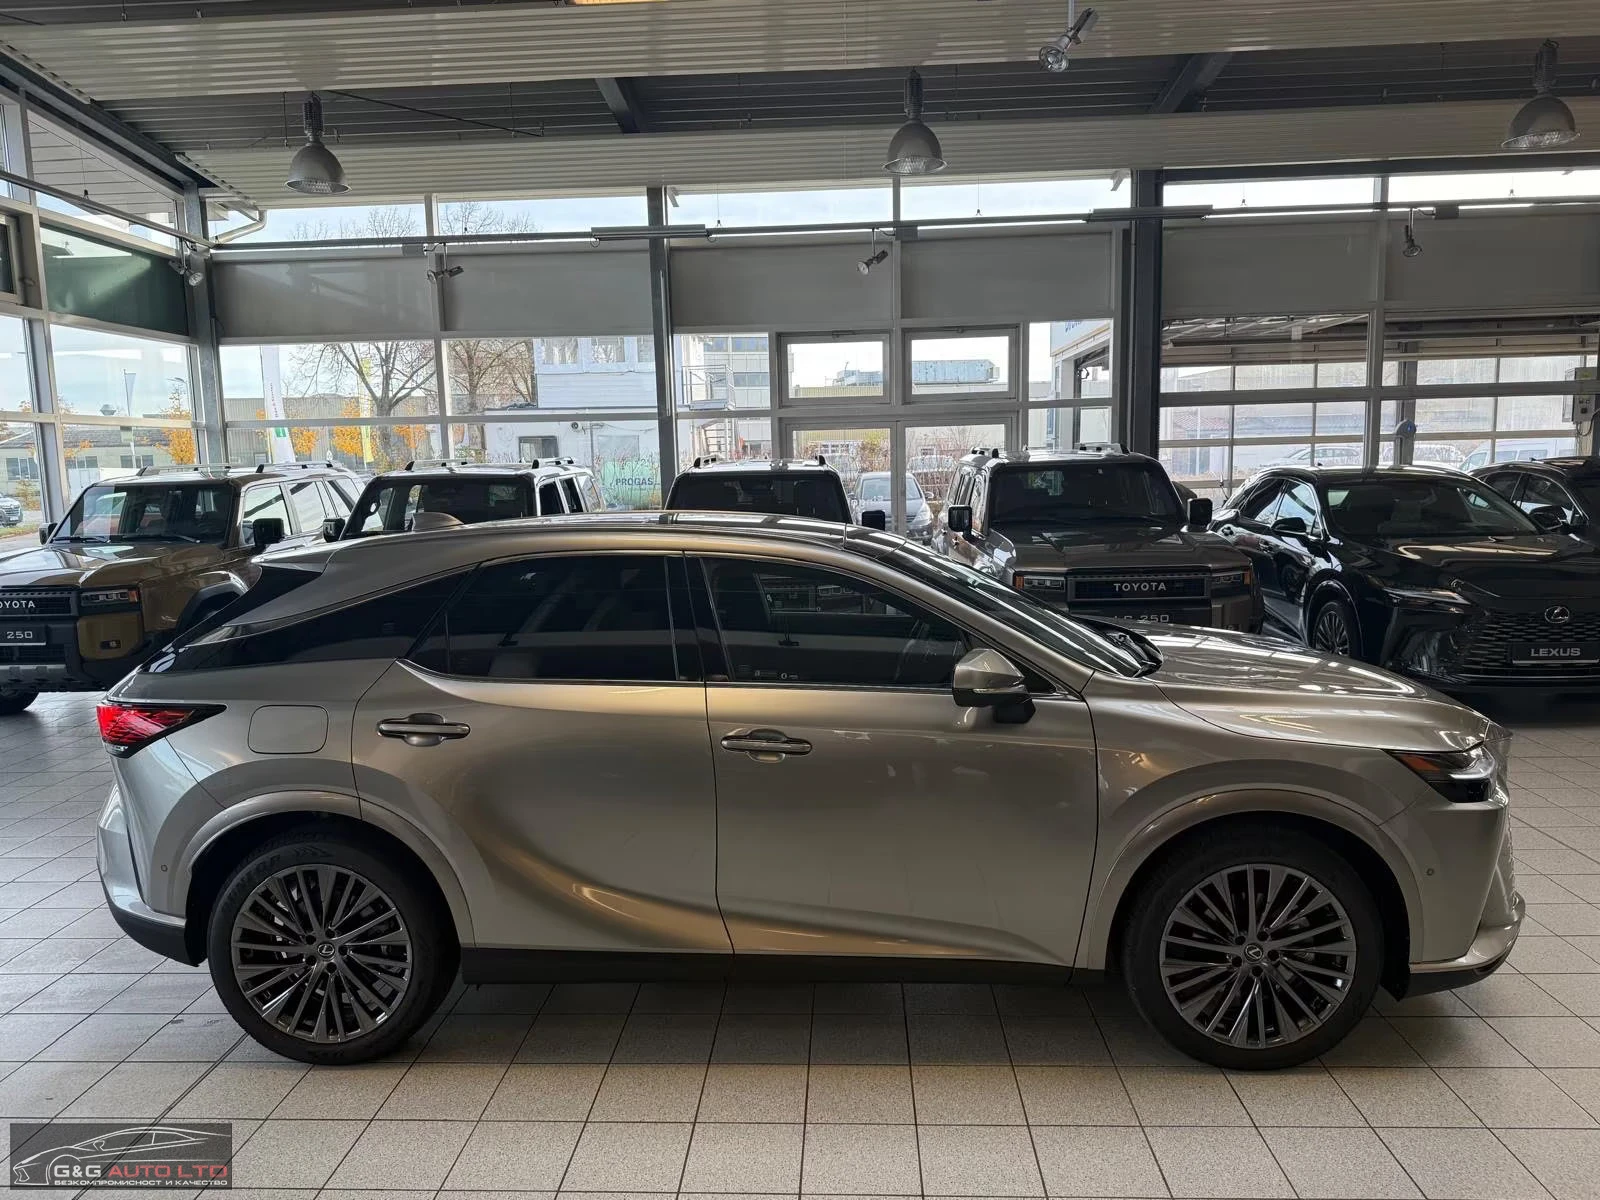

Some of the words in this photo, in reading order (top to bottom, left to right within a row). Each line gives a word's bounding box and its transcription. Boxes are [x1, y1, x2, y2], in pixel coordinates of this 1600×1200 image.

[616, 478, 654, 486] PROGAS
[1113, 582, 1167, 592] TOYOTA
[1140, 614, 1170, 623] 250
[6, 631, 33, 639] 250
[1530, 647, 1581, 657] LEXUS
